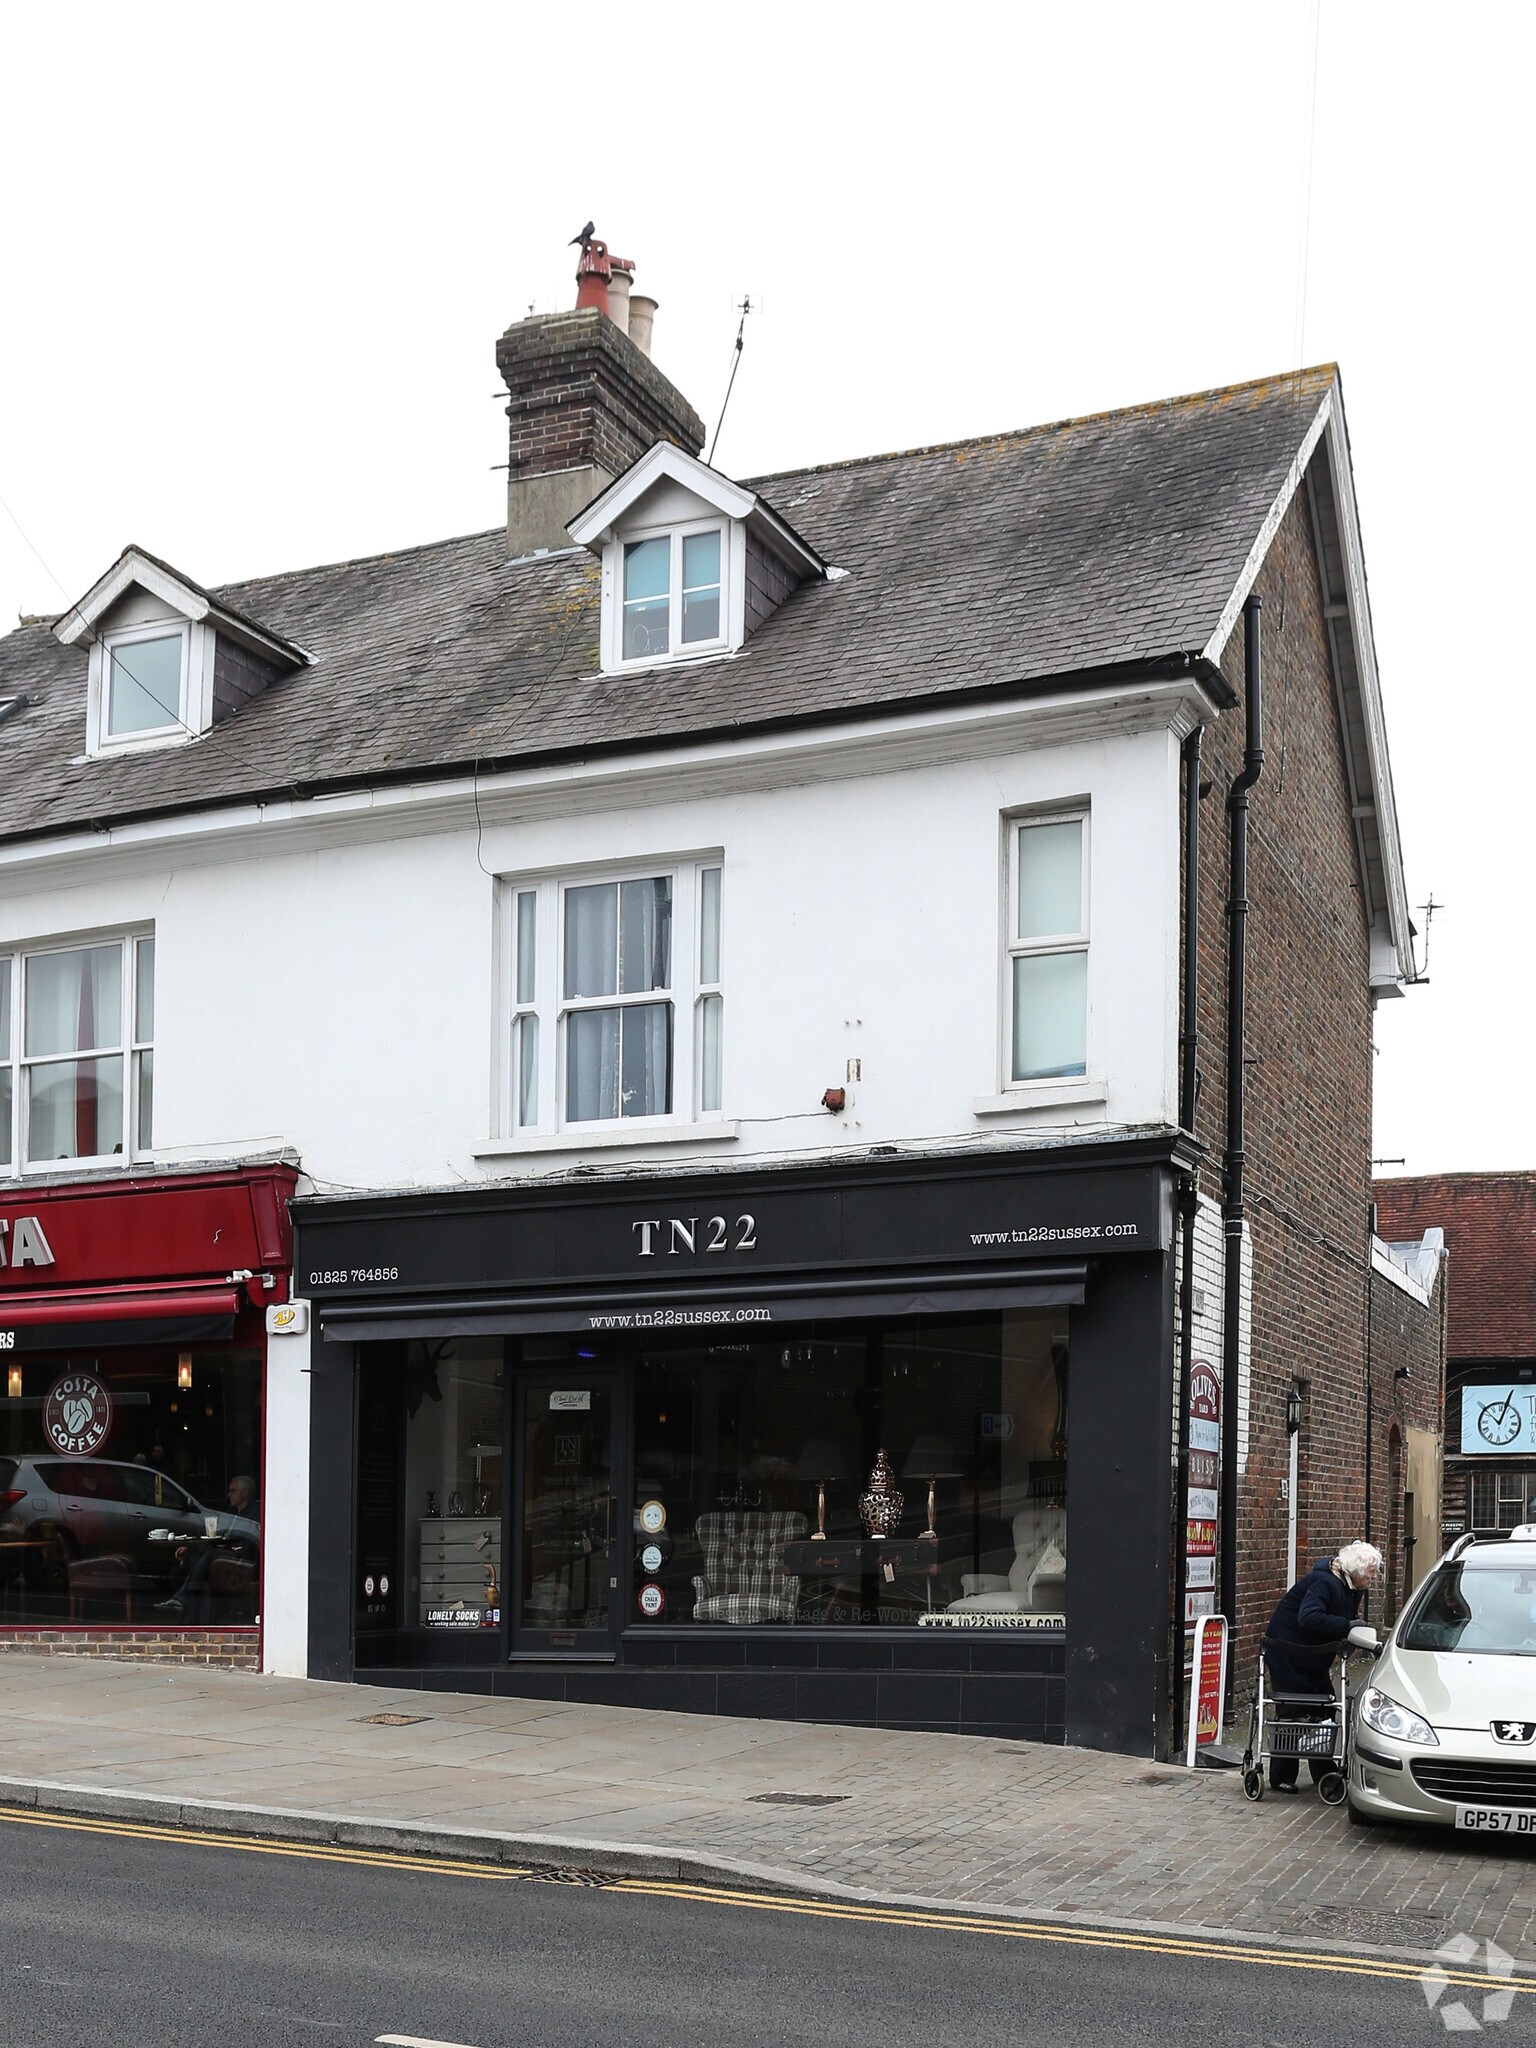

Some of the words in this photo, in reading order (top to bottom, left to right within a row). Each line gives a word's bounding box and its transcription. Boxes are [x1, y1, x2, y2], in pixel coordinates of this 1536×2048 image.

[632, 1214, 757, 1255] TN22
[970, 1223, 1138, 1245] www.tn22sussex.com
[310, 1270, 348, 1284] 01825
[351, 1267, 398, 1282] 764856
[589, 1308, 771, 1328] www.tn22sussex.com
[55, 1377, 98, 1401] COSTA
[1191, 1374, 1217, 1407] OLIVES
[51, 1422, 104, 1451] COFFEE
[1191, 1457, 1214, 1474] BLISS
[428, 1610, 454, 1621] LONELY
[455, 1610, 480, 1621] SOCKS
[1464, 1810, 1512, 1830] GP57
